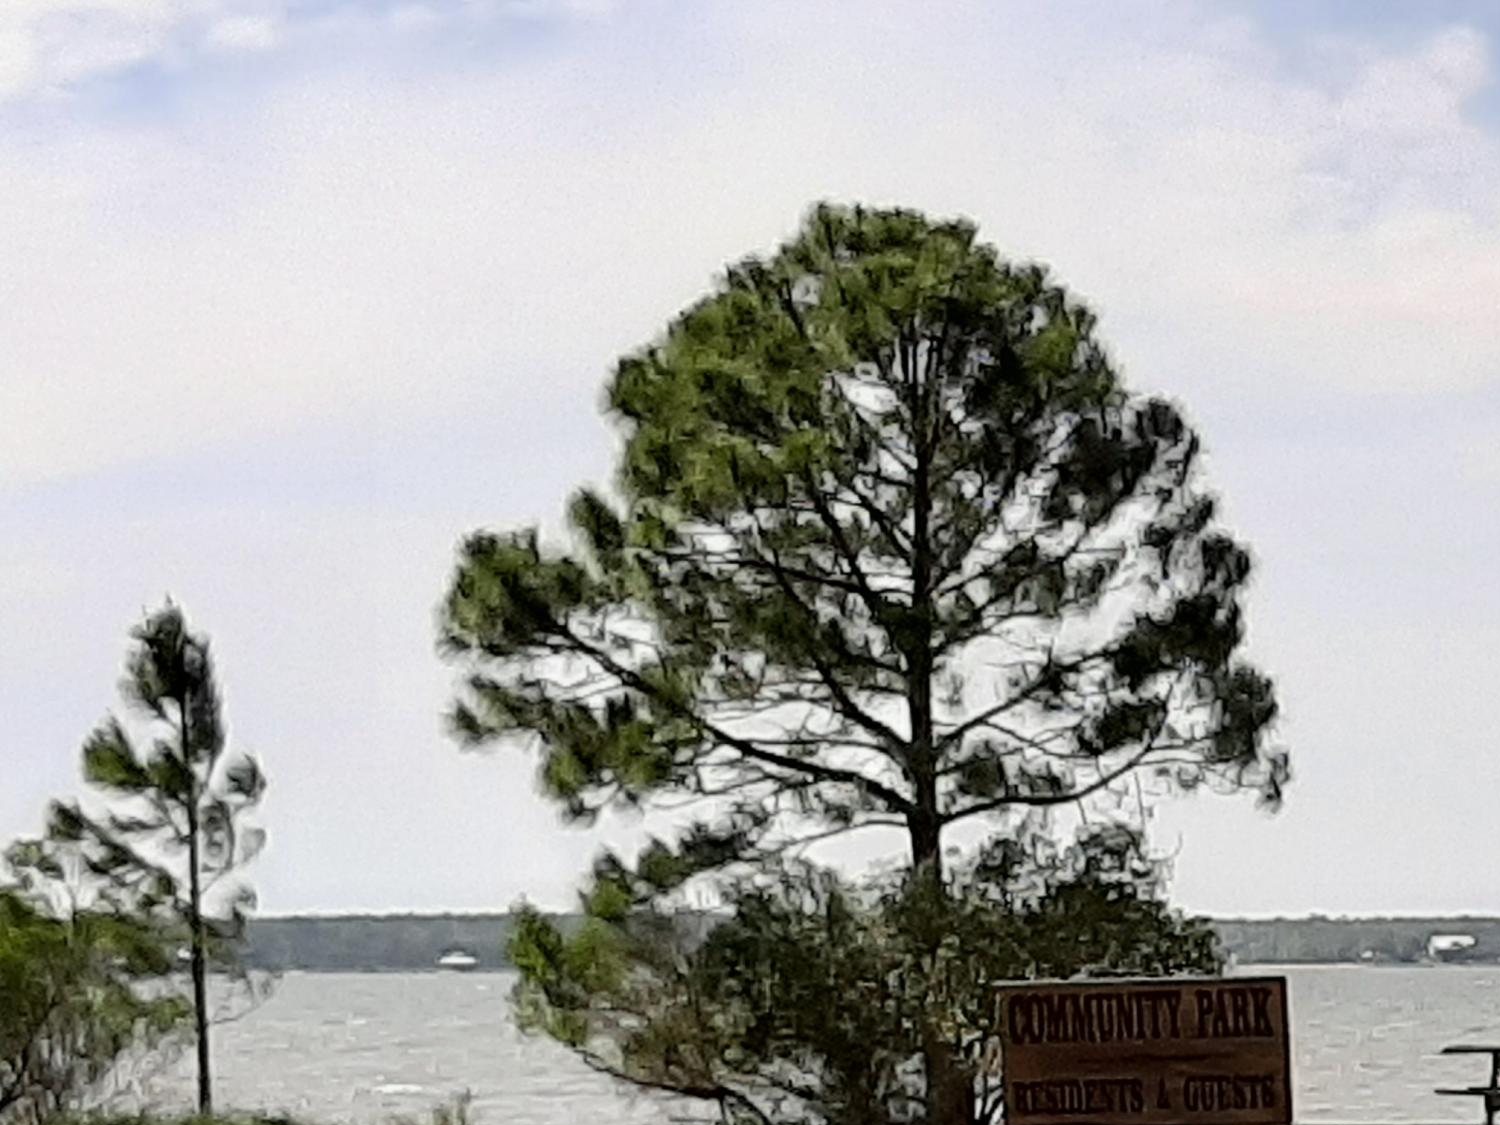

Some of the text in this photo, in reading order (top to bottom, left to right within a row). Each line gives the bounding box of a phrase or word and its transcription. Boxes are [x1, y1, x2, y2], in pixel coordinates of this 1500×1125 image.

[1008, 988, 1274, 1044] COMMUNITY PARK
[1012, 1078, 1144, 1113] RESIDENTS
[1183, 1074, 1275, 1112] GUESTS
